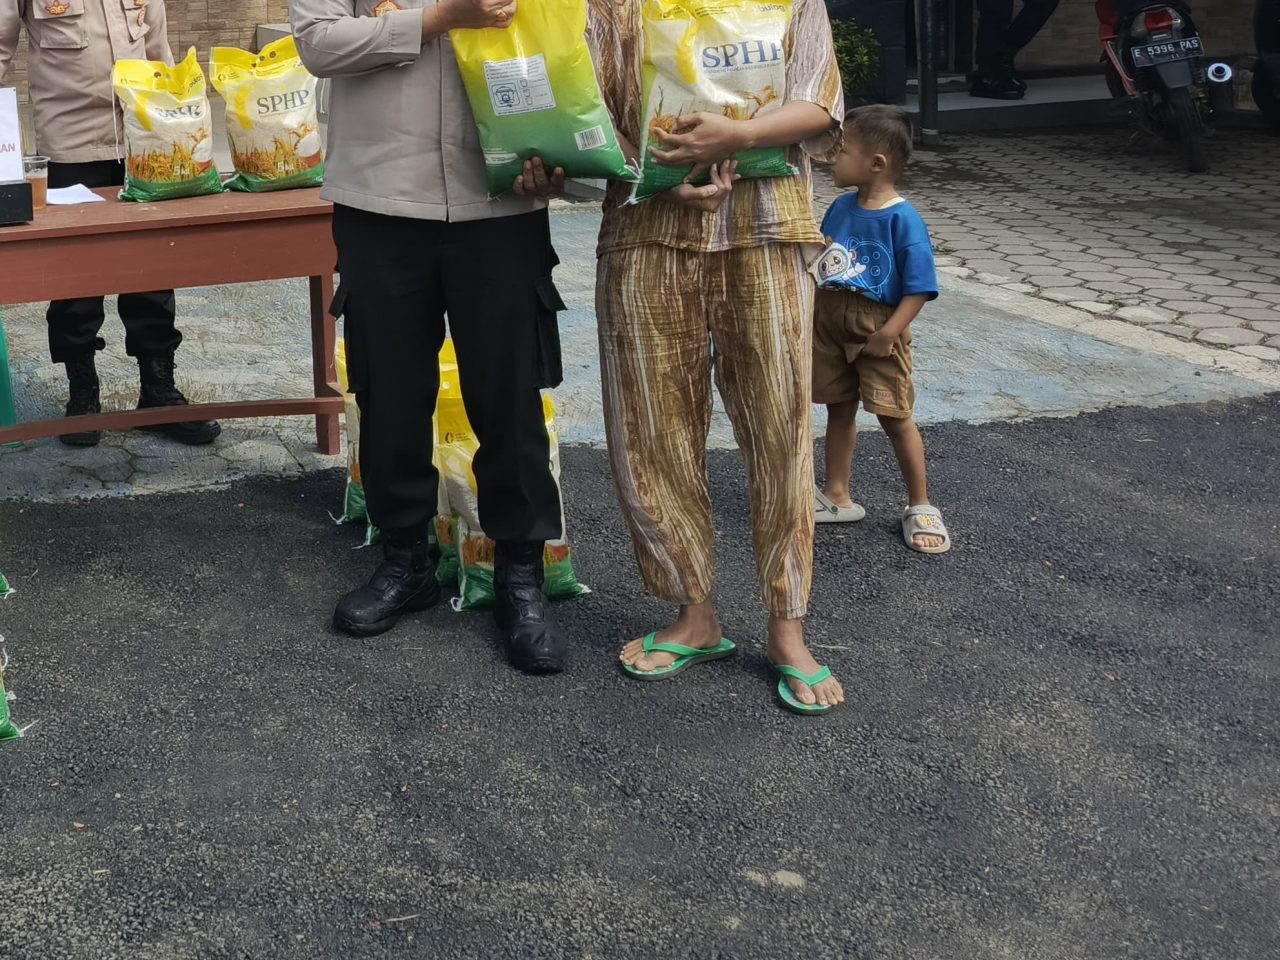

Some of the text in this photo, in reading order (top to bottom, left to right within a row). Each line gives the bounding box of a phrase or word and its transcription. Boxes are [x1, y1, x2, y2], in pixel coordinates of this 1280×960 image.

[1134, 39, 1199, 58] E 5396 PAS
[256, 89, 310, 115] SPHP
